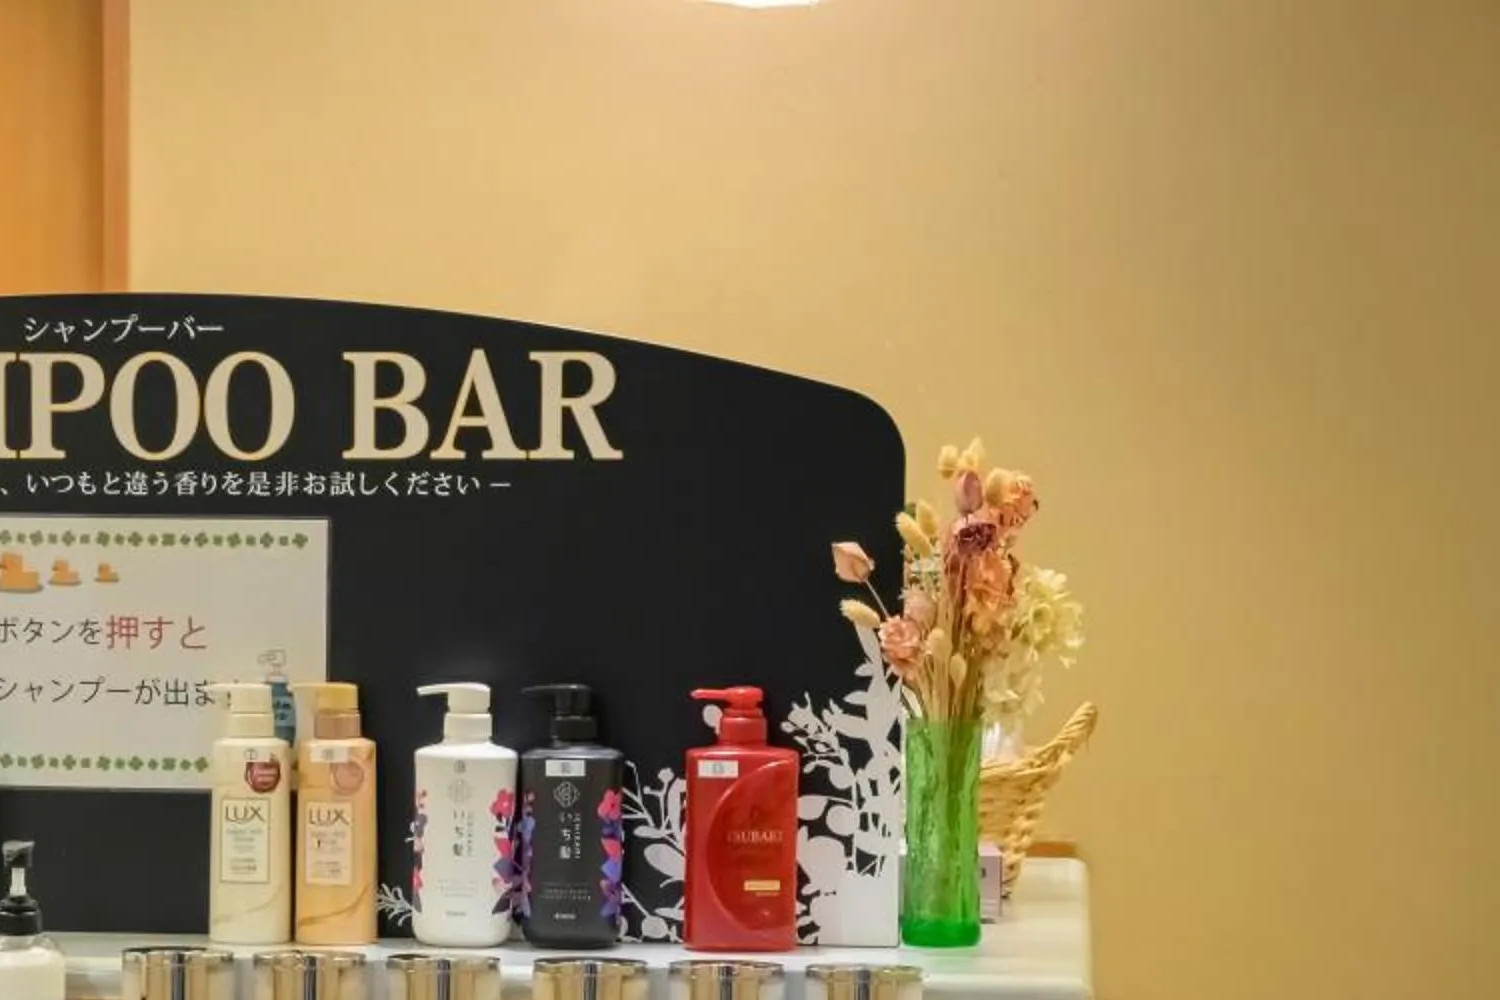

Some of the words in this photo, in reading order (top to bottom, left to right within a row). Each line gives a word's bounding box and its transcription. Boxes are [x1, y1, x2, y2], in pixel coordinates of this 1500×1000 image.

[23, 314, 225, 342] シャンプーバー
[341, 347, 624, 460] BAR
[225, 805, 265, 824] LUX
[309, 808, 349, 826] LUX
